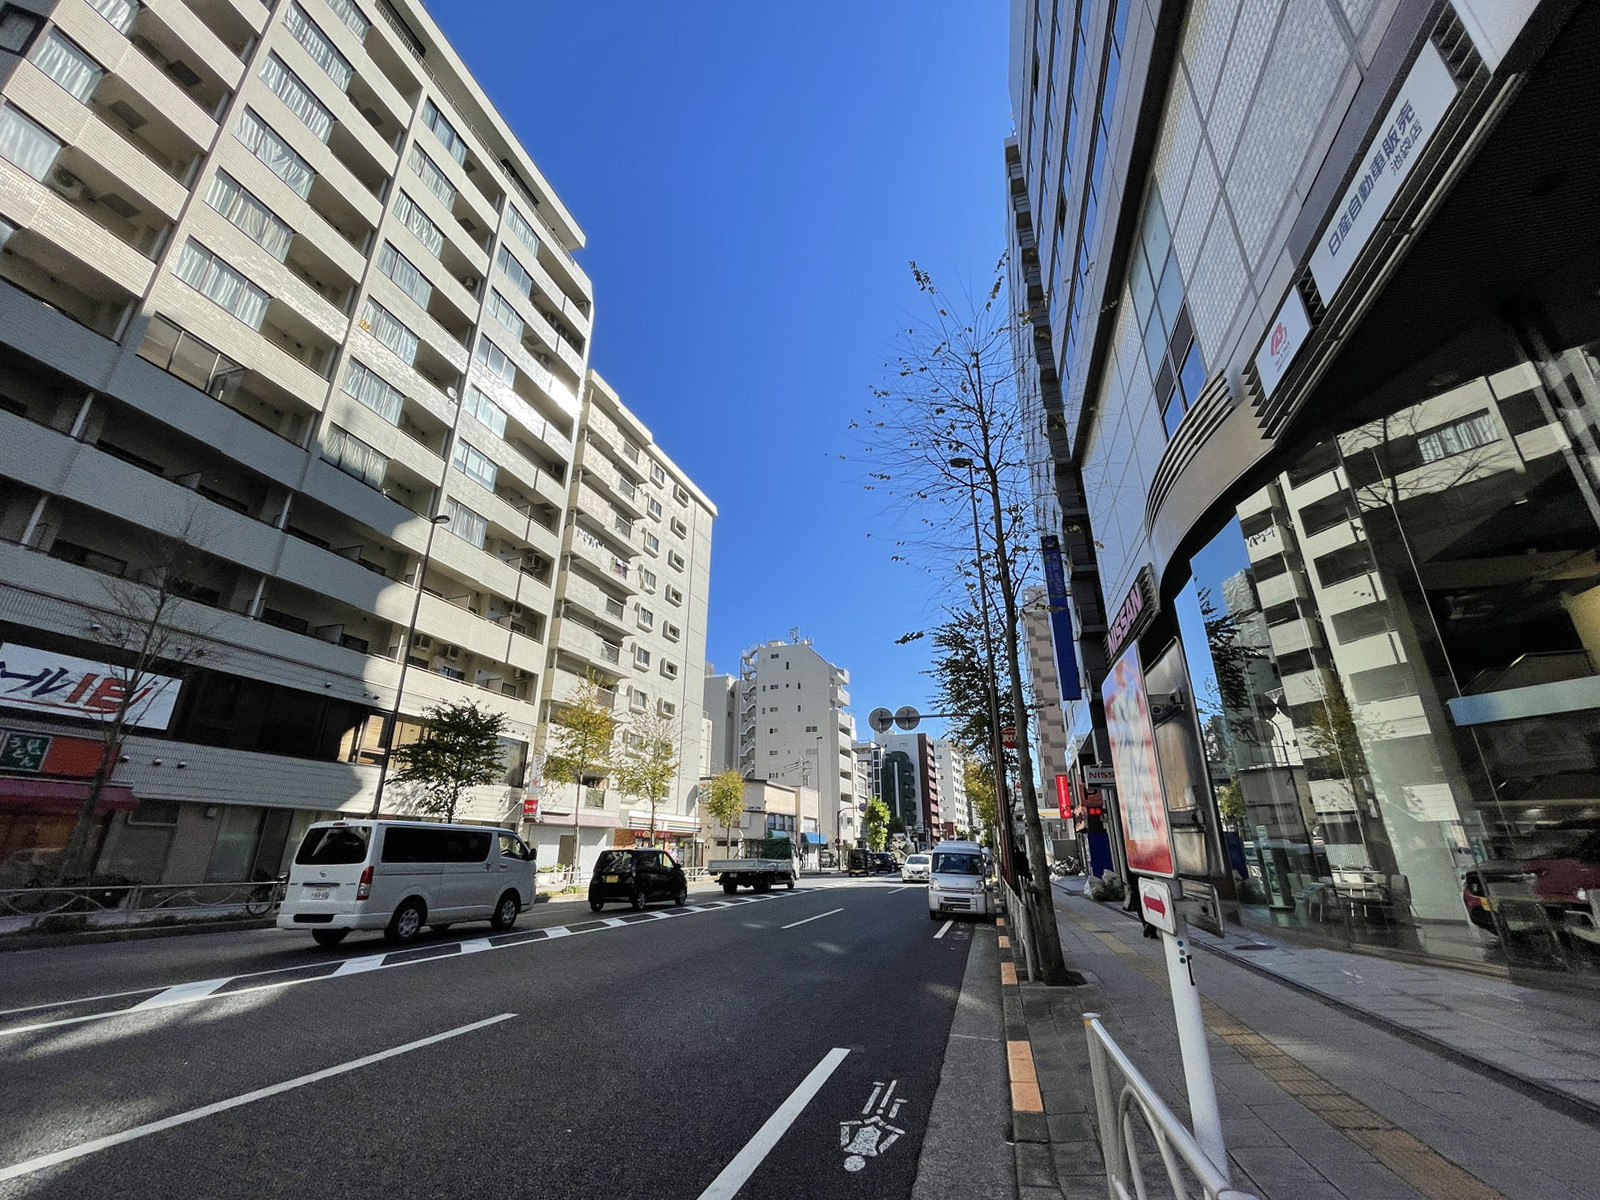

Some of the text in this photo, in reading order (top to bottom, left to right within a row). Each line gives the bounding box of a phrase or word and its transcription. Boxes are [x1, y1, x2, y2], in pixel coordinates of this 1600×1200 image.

[1328, 99, 1415, 257] 日産自動車販売
[1390, 119, 1423, 176] 池袋店
[1107, 581, 1144, 659] NISSAN
[1089, 771, 1115, 779] NISS
